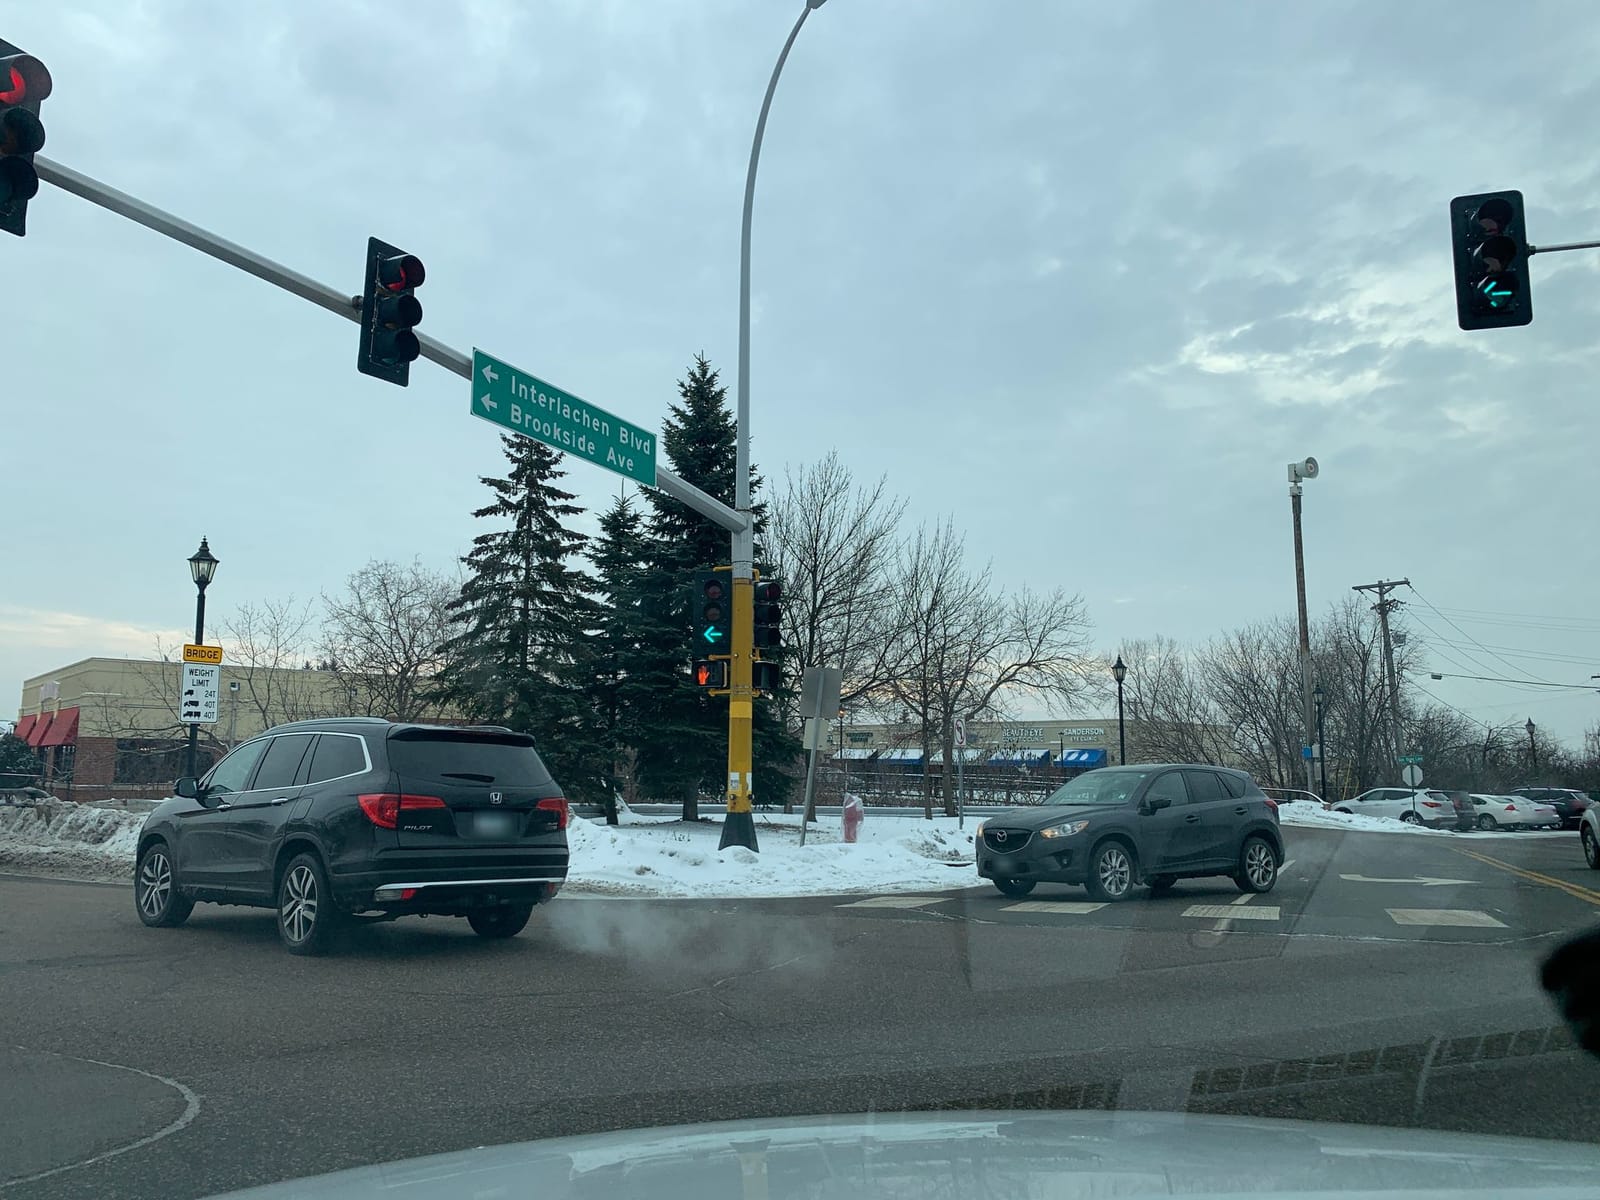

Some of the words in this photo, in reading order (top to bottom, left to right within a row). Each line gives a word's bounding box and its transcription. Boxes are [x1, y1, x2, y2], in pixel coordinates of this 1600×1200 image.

[511, 375, 610, 437] Interlachen
[619, 426, 651, 455] Blvd
[510, 403, 596, 455] Brookside
[606, 447, 634, 472] Ave
[186, 648, 219, 659] BRIDGE
[189, 668, 214, 677] WEIGHT
[192, 679, 209, 687] LIMIT
[204, 690, 216, 698] 24T
[203, 711, 215, 719] 40T
[1063, 727, 1104, 736] SANDERSON
